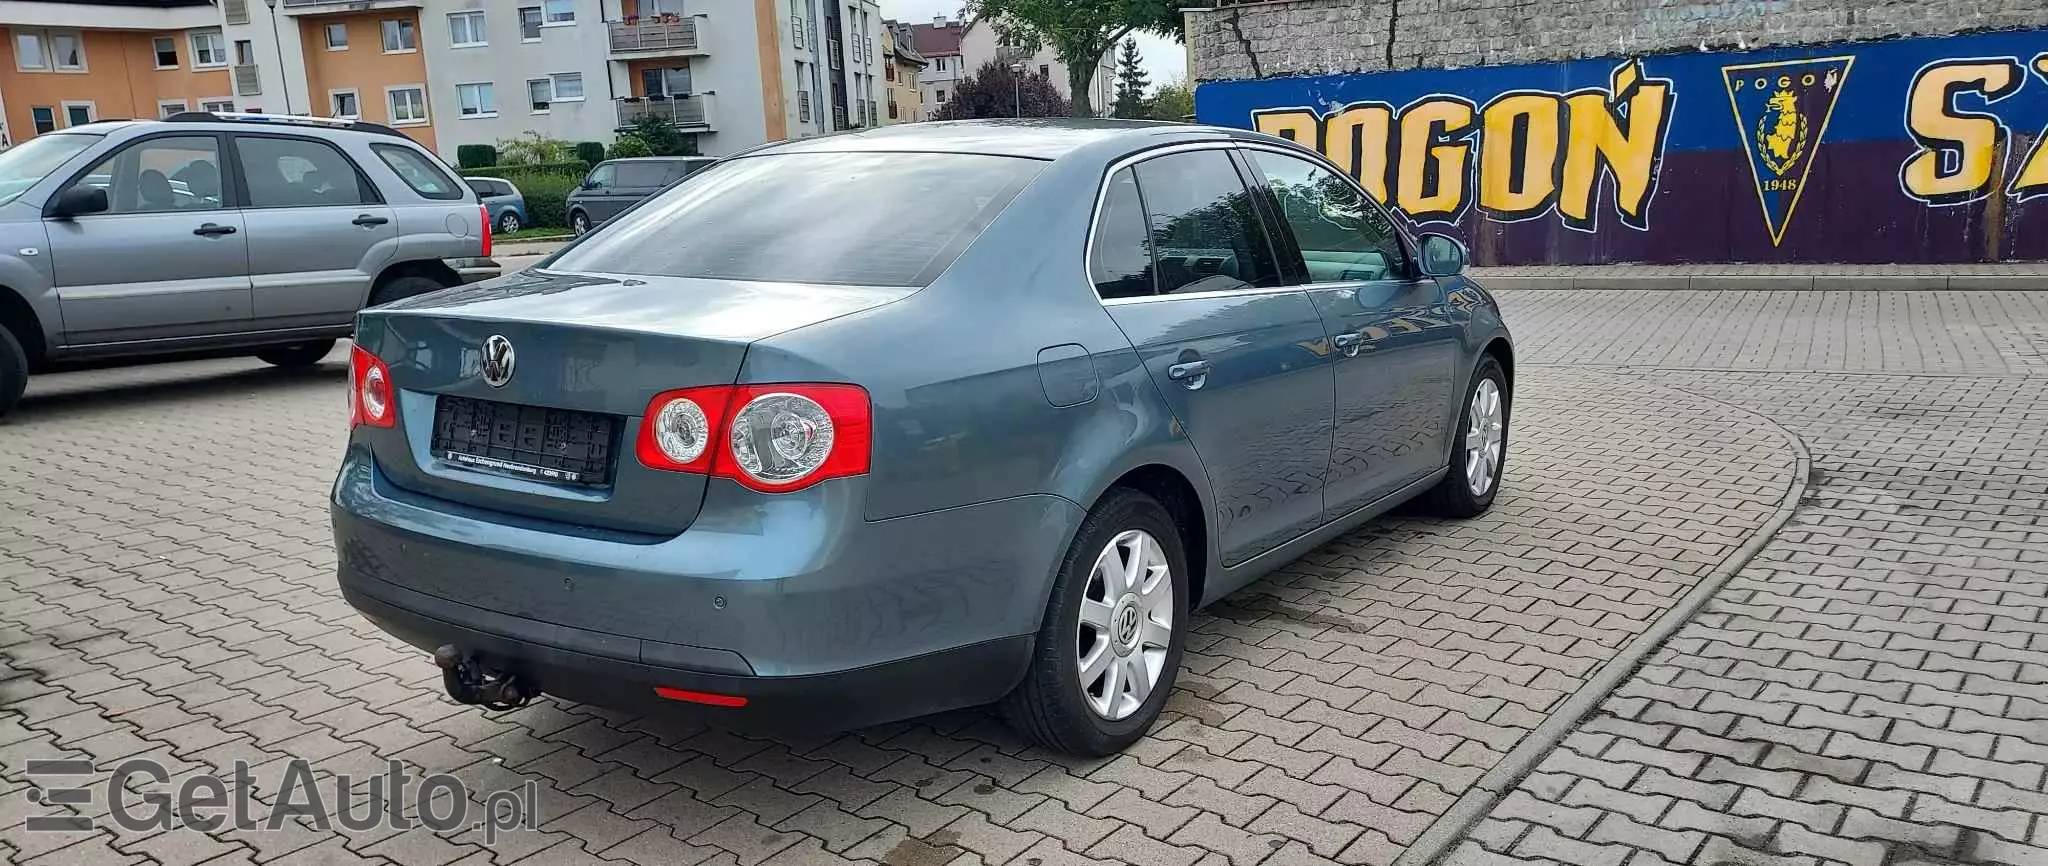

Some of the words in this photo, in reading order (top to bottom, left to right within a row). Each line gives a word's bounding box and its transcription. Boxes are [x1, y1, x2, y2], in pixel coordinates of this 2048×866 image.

[1734, 66, 1838, 93] POGO
[1762, 179, 1798, 191] 1948
[481, 335, 515, 387] VW
